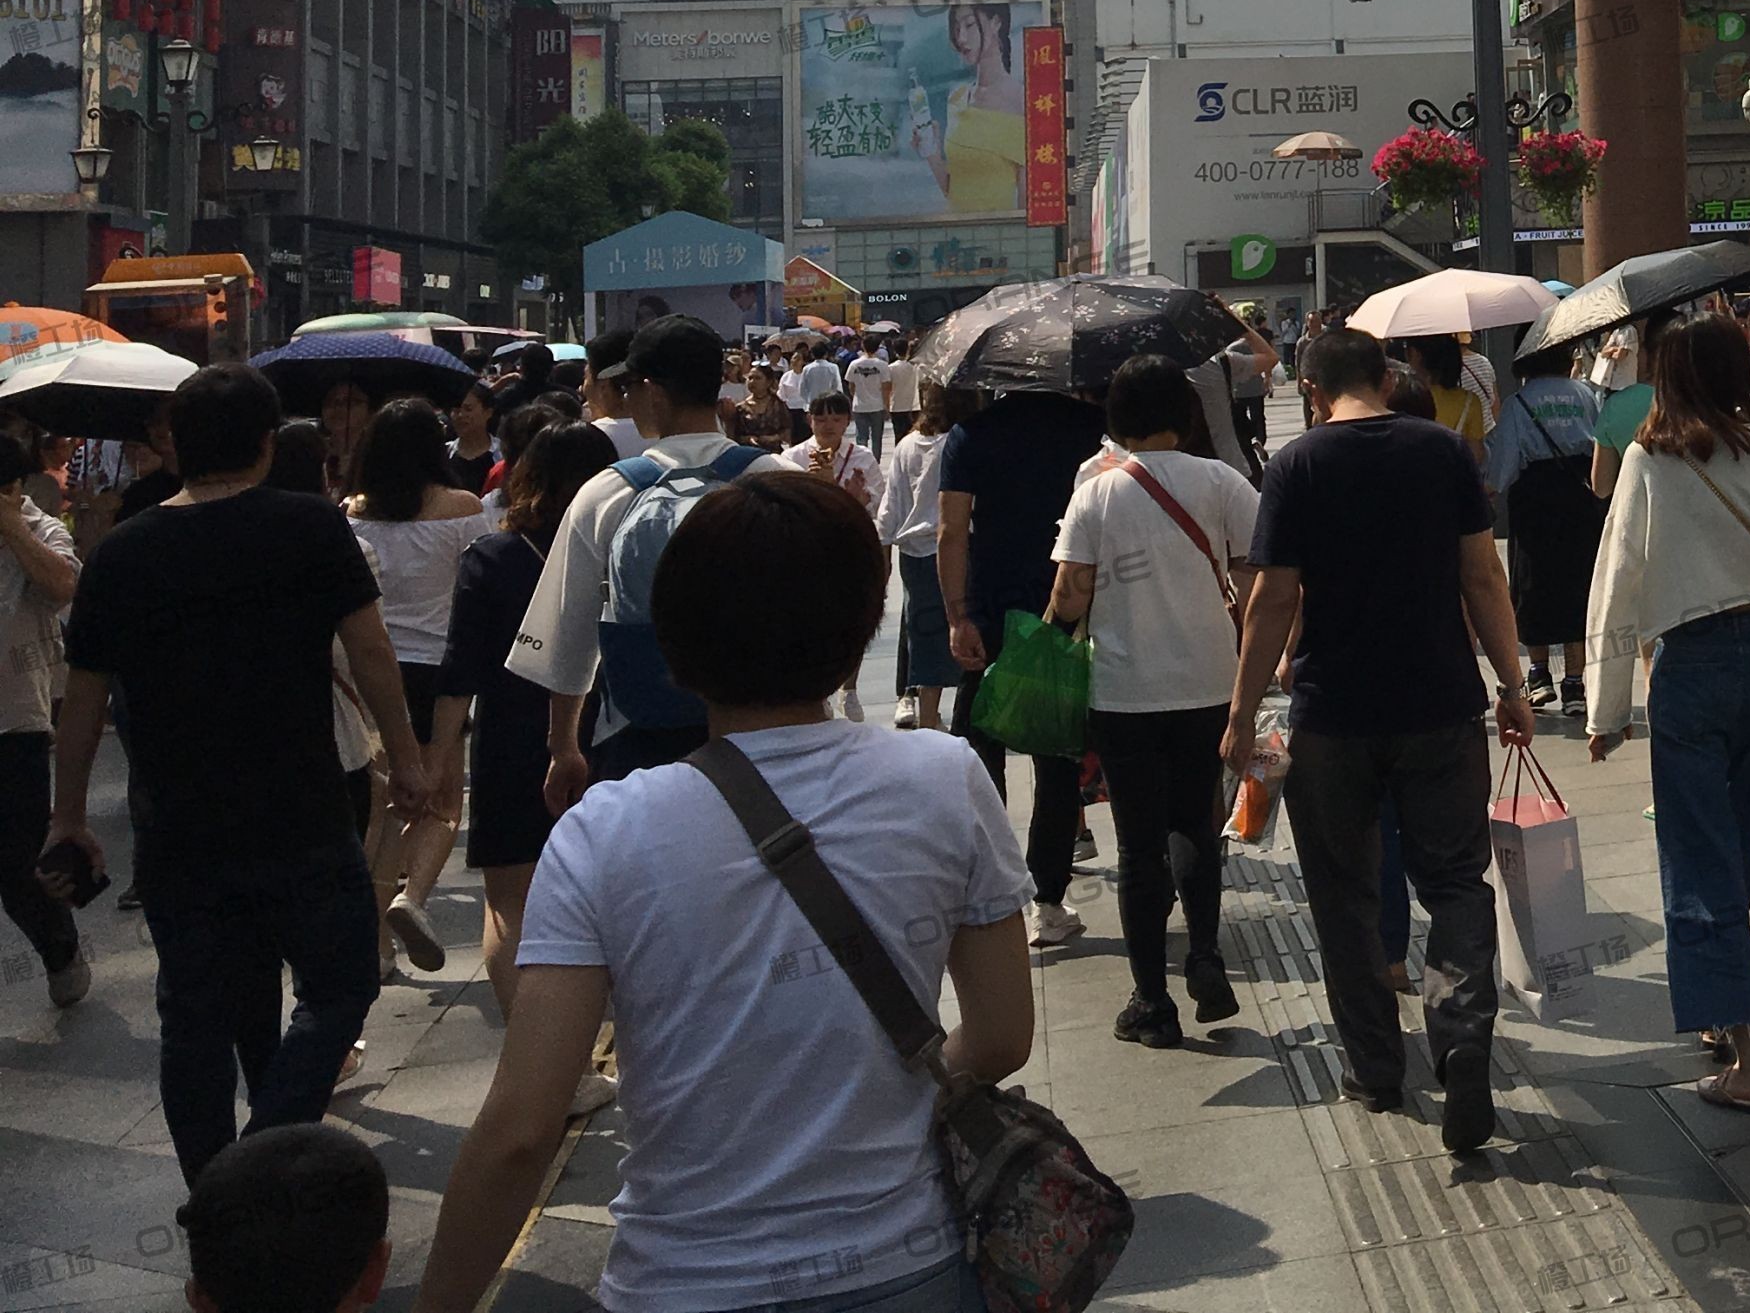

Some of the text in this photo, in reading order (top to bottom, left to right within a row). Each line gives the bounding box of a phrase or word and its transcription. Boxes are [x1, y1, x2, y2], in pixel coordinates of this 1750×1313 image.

[1194, 158, 1360, 183] 400-0777-188
[1529, 230, 1556, 239] FRUIT
[1557, 229, 1584, 238] JUCE
[868, 293, 908, 303] BOLON
